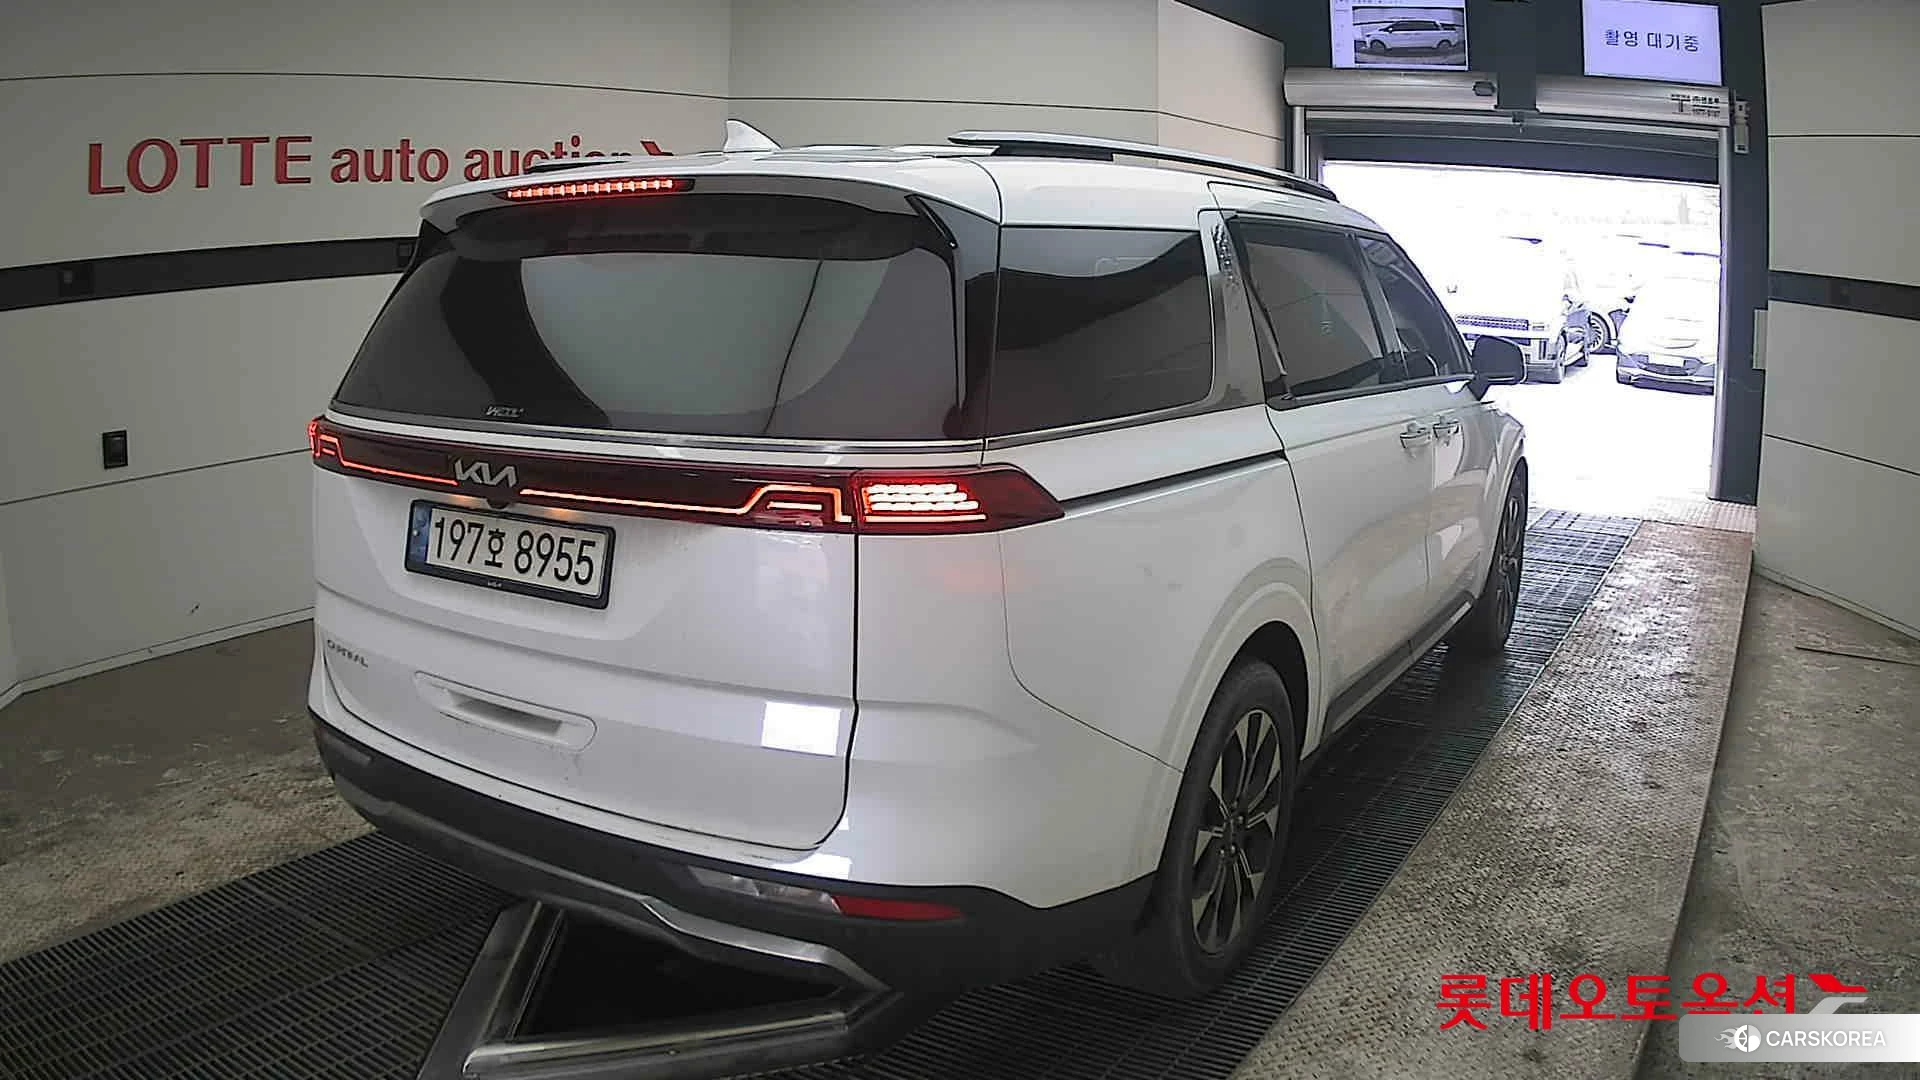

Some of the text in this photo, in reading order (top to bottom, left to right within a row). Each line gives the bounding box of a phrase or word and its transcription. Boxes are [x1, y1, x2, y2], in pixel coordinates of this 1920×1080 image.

[1647, 32, 1698, 52] 대기중
[88, 136, 312, 195] LOTTE
[330, 138, 449, 184] auto
[454, 461, 517, 488] KIA
[434, 517, 596, 586] 197호 8955
